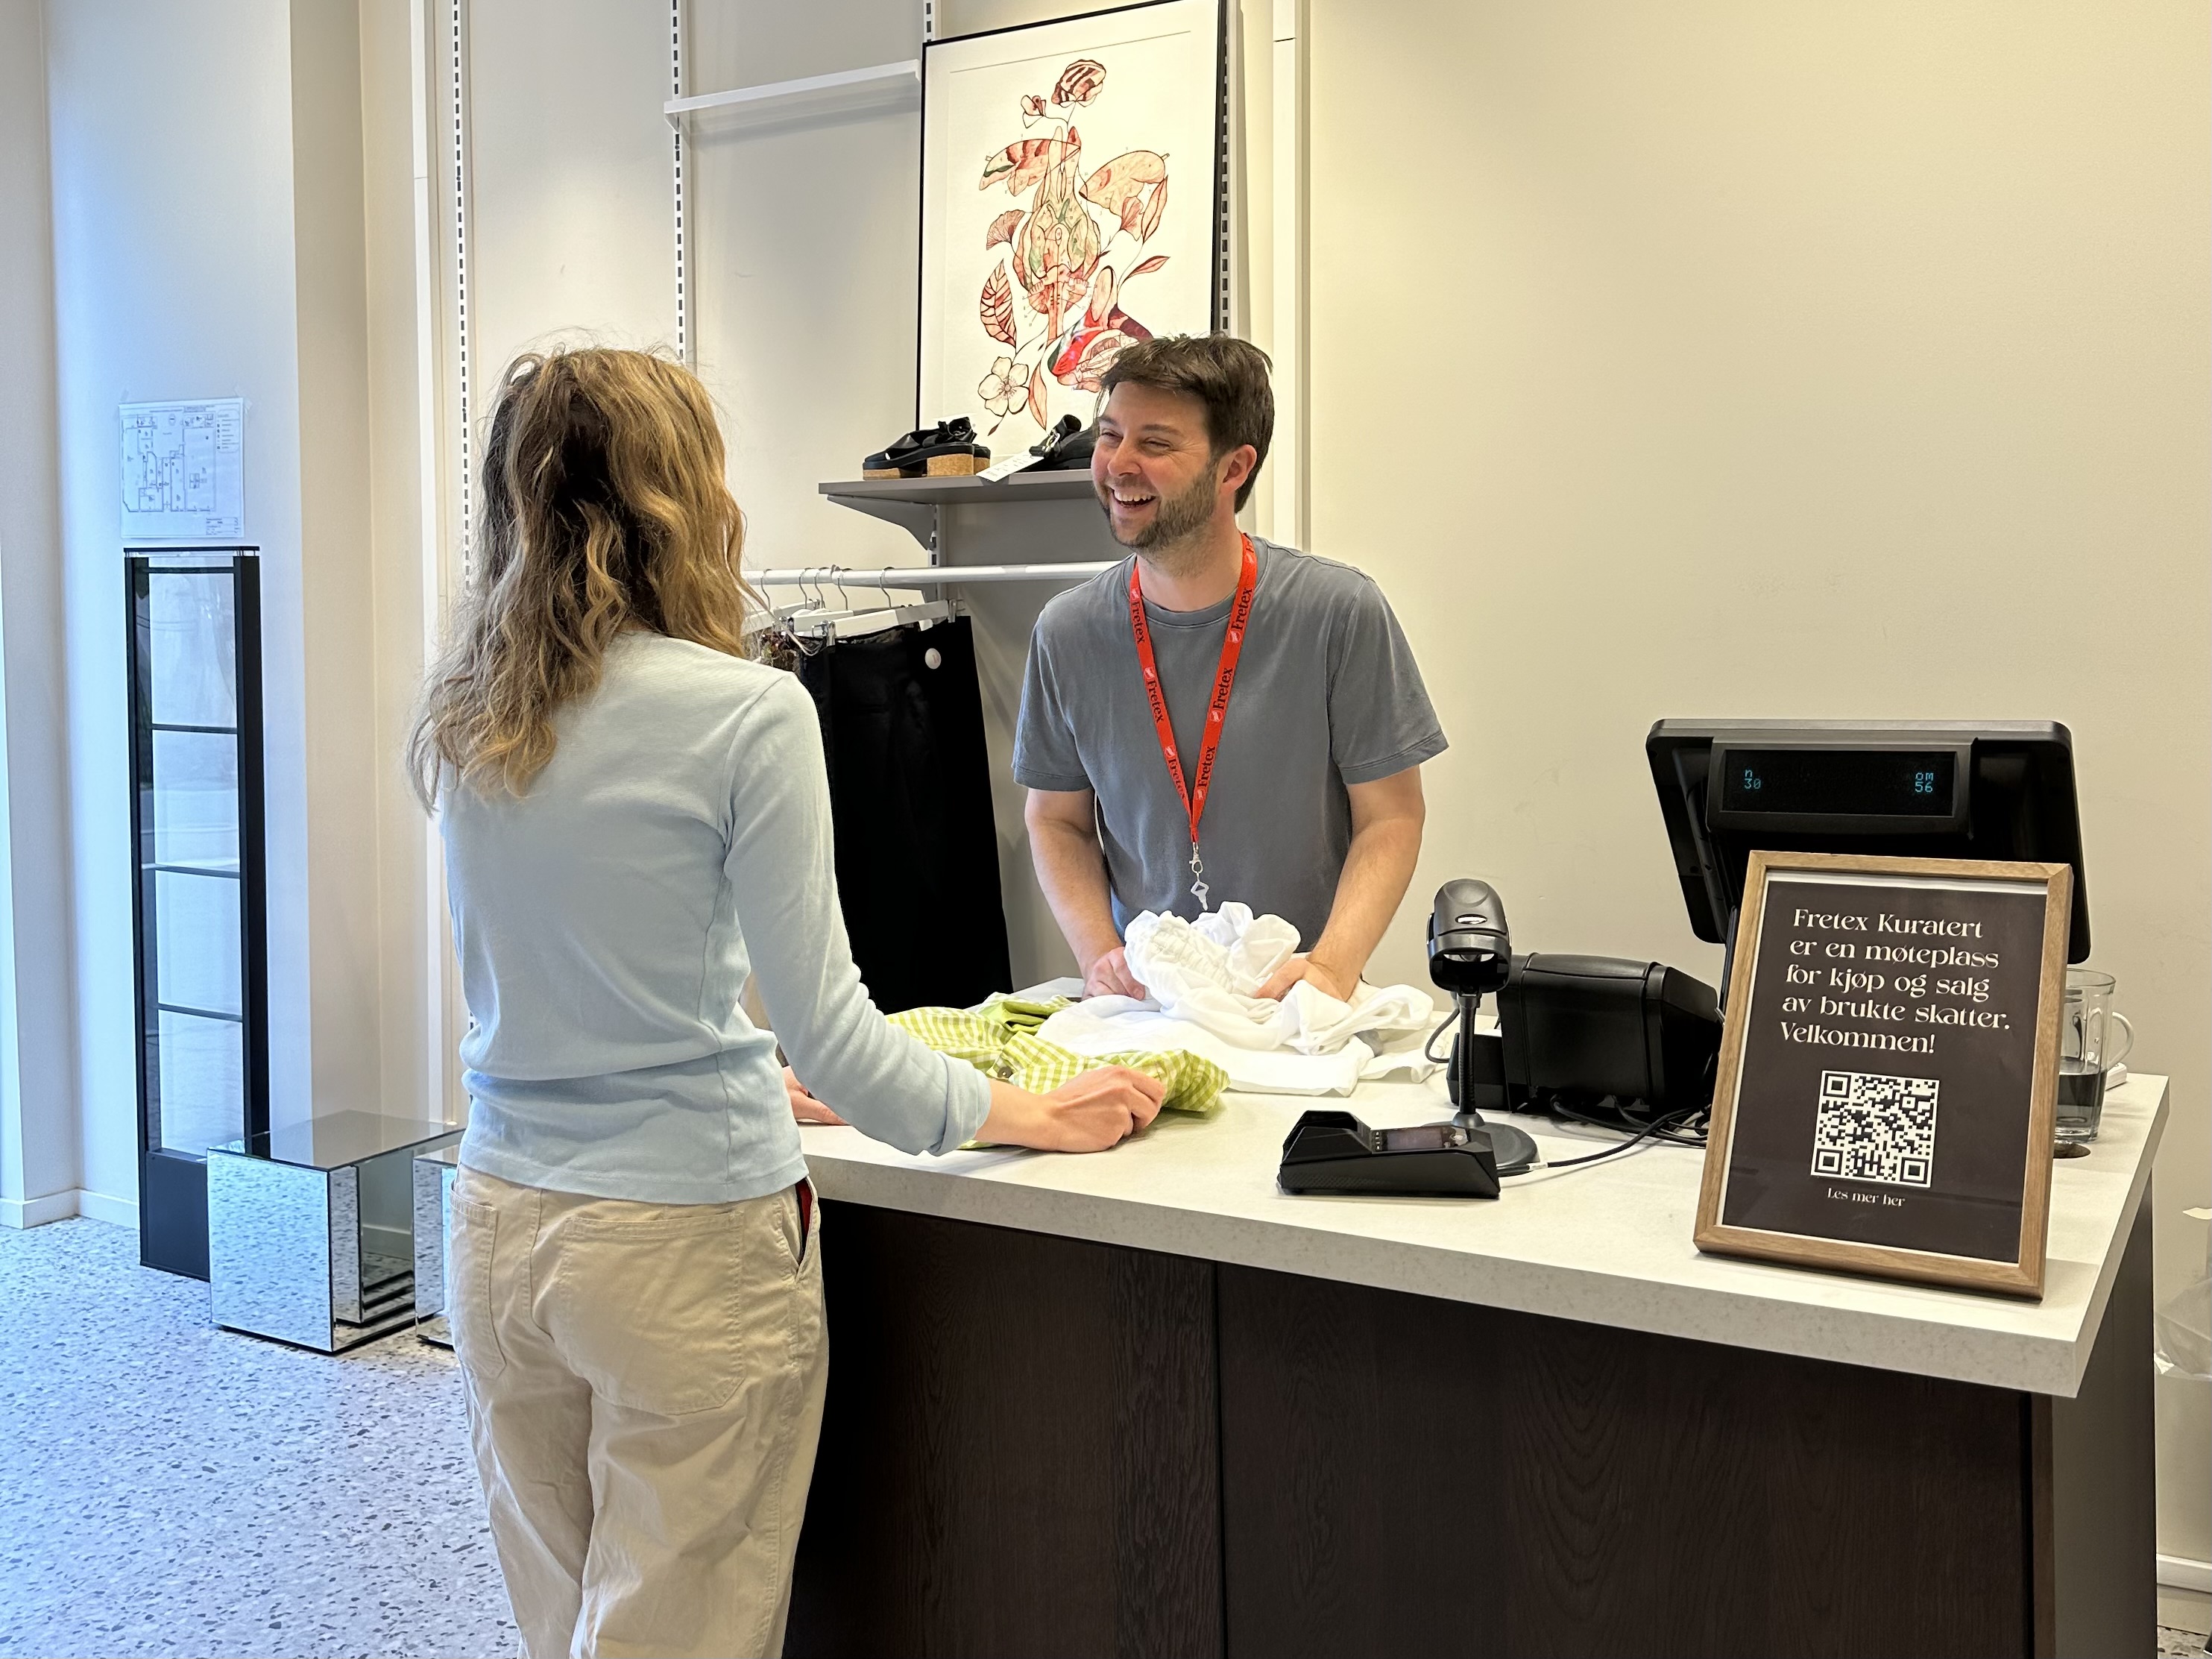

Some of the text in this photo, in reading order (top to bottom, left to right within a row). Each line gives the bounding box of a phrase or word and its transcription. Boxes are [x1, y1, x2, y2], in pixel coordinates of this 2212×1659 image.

[1131, 600, 1145, 644] Fretex
[1231, 587, 1252, 631] Fretex
[1147, 679, 1164, 723] Fretex
[1212, 667, 1233, 711] Fretex
[1197, 746, 1216, 787] Fretex
[1744, 778, 1933, 793] 30 56
[1793, 907, 1984, 939] Fretex Kuratert
[1789, 939, 2000, 969] er en møteplass
[1786, 964, 1990, 1003] for kjøp og salg
[1782, 995, 2010, 1030] av brukte skatter.
[1780, 1021, 1935, 1054] Velkommen!
[1827, 1187, 1906, 1206] Les mer her
